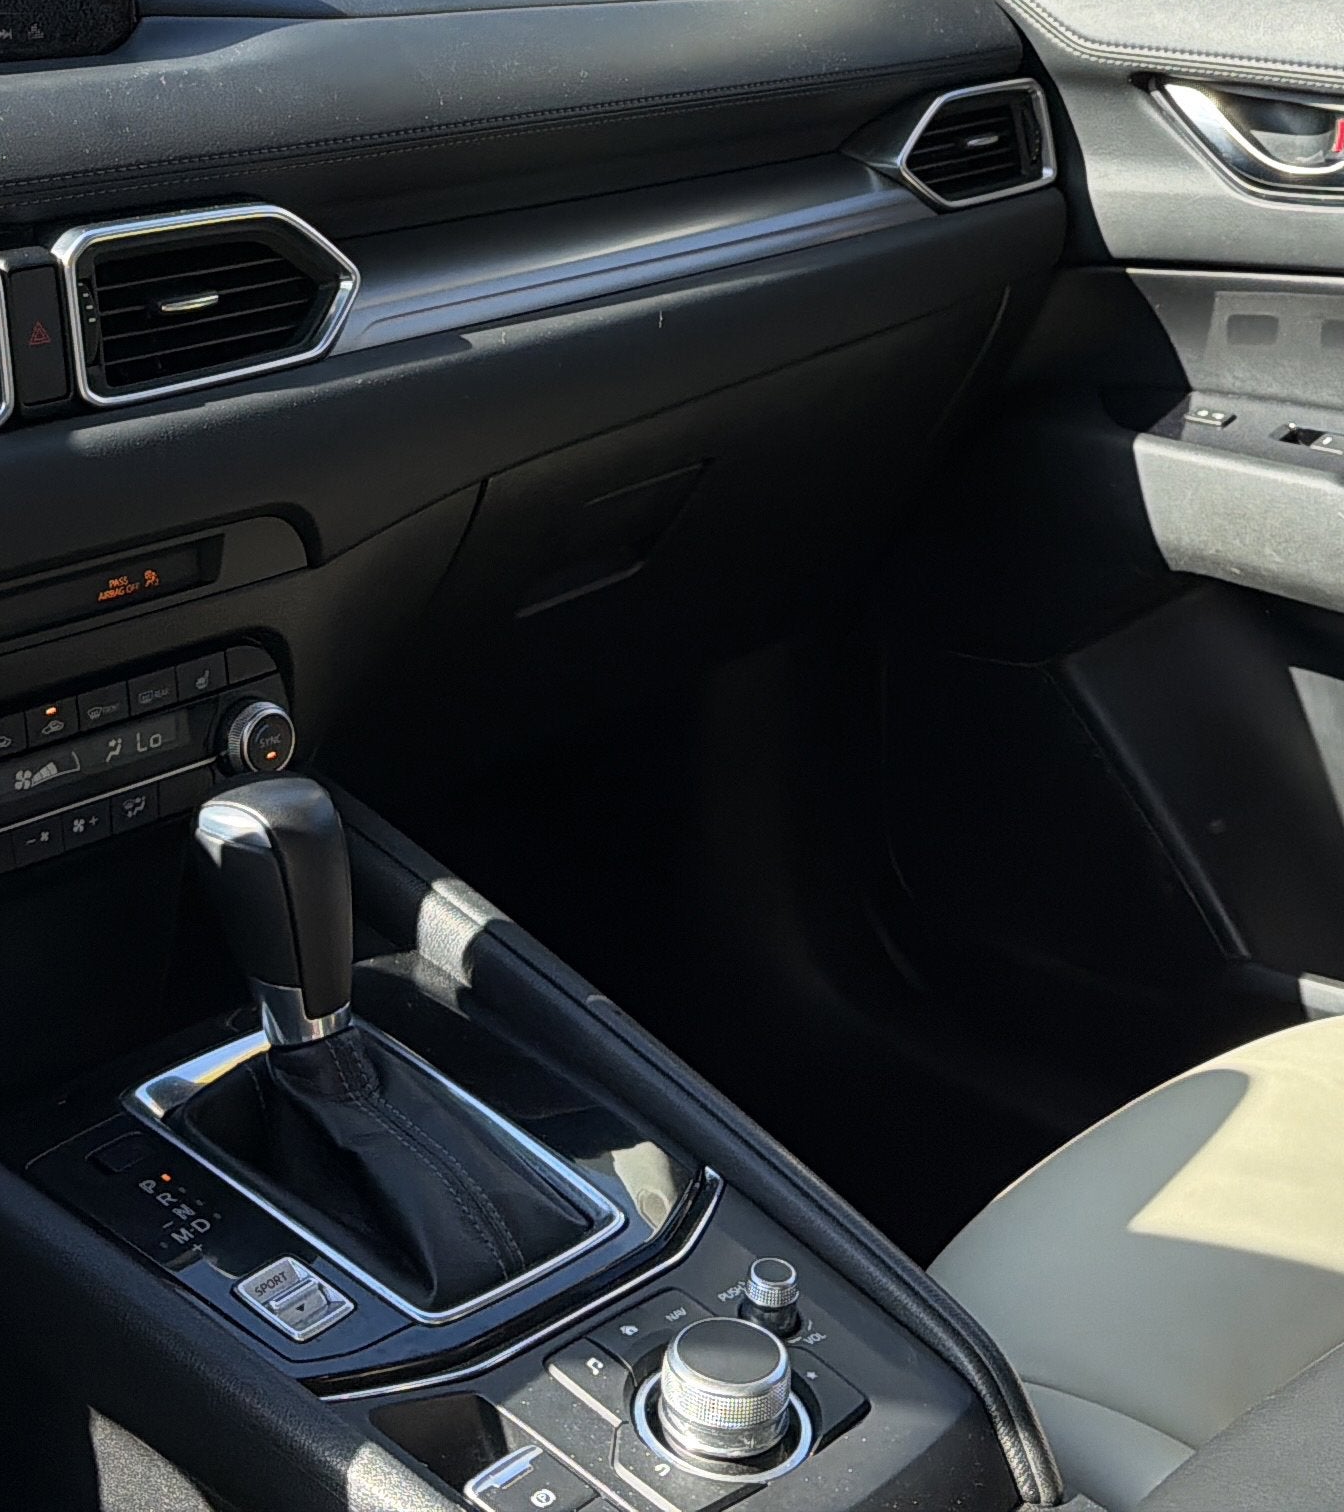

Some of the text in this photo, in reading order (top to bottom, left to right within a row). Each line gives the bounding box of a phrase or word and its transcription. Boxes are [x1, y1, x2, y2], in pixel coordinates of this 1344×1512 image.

[108, 575, 129, 588] PASS
[259, 733, 281, 748] SYNC
[138, 1179, 157, 1194] P
[156, 1192, 178, 1206] R
[171, 1203, 196, 1220] N
[254, 1272, 288, 1297] SPORT
[717, 1282, 745, 1302] PUSH
[665, 1307, 687, 1322] NAV
[803, 1332, 827, 1345] VOL
